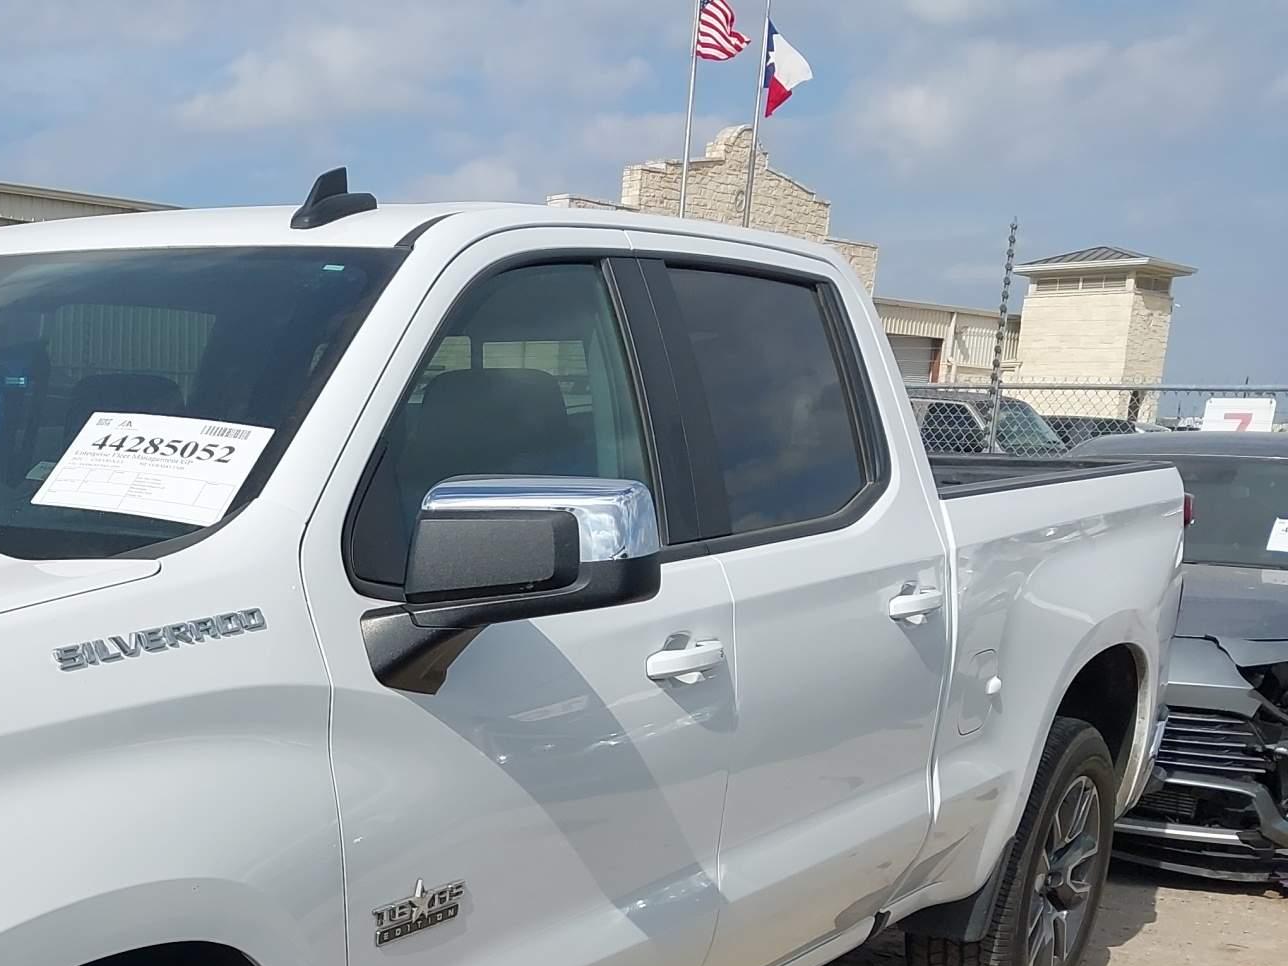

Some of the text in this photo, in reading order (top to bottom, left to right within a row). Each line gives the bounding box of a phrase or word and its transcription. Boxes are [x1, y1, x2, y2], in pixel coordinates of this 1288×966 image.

[91, 433, 236, 464] 44285052
[53, 607, 267, 672] SILVERADO
[383, 908, 456, 940] EDITION
